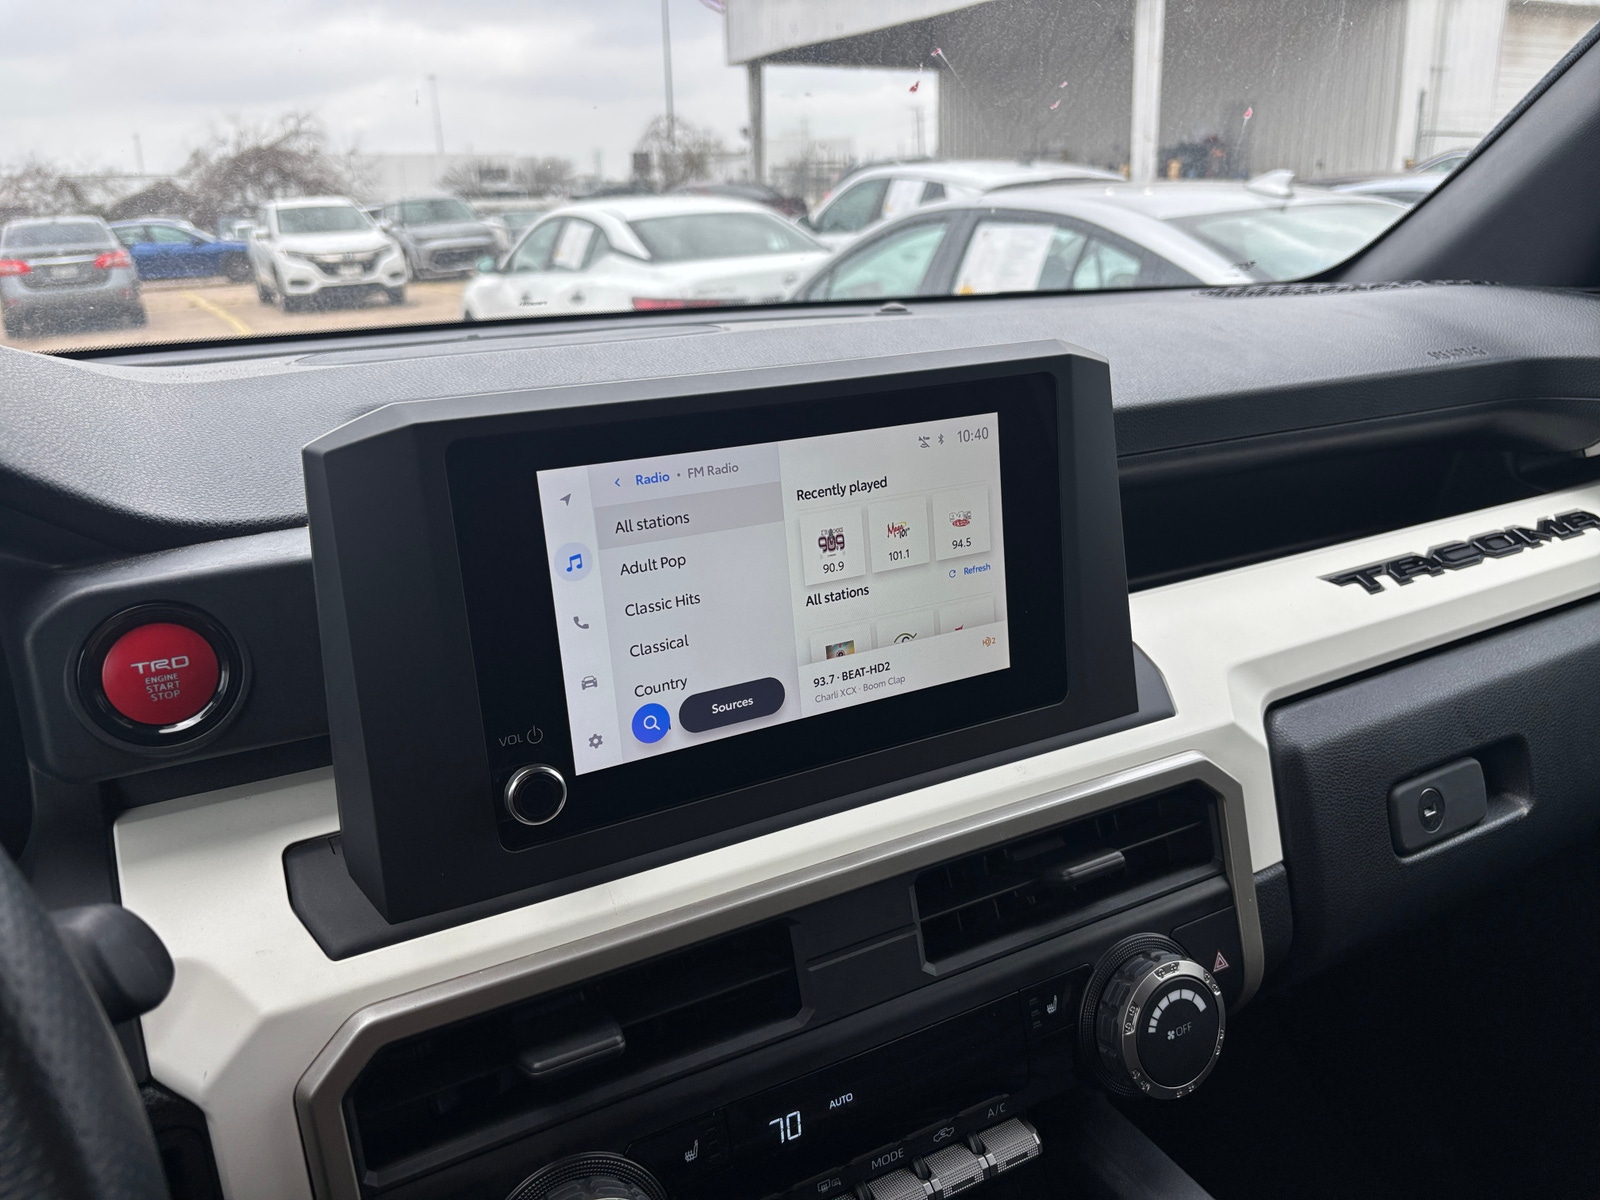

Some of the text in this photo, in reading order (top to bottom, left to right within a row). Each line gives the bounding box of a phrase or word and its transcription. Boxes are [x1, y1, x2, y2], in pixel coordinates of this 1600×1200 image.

[957, 427, 989, 443] 10:40
[635, 471, 670, 486] Radio
[687, 462, 739, 479] FM Radio
[796, 475, 888, 501] Recently played
[615, 512, 690, 534] All stations
[951, 537, 972, 550] 94.5
[1317, 508, 1600, 595] TACOMA
[888, 549, 910, 561] 101.1
[620, 555, 687, 576] Adult Pop
[822, 560, 845, 574] 90.9
[963, 563, 991, 576] Refresh
[805, 585, 870, 607] All stations
[624, 593, 701, 617] Classic Hits
[629, 634, 690, 658] Classical
[130, 655, 190, 675] TRD
[145, 673, 179, 685] ENGINE
[812, 661, 891, 688] 93.7 BEAT-HD2
[146, 680, 181, 694] START
[634, 677, 688, 698] Country
[814, 675, 906, 703] Charli XCX Boom Clap
[150, 690, 181, 702] STOP
[711, 697, 754, 714] Sources
[498, 733, 523, 747] VOL
[1175, 1021, 1193, 1037] OFF
[829, 1092, 854, 1109] AUTO
[986, 1102, 1006, 1119] A/C
[768, 1110, 802, 1144] 70
[871, 1147, 905, 1171] MODE
